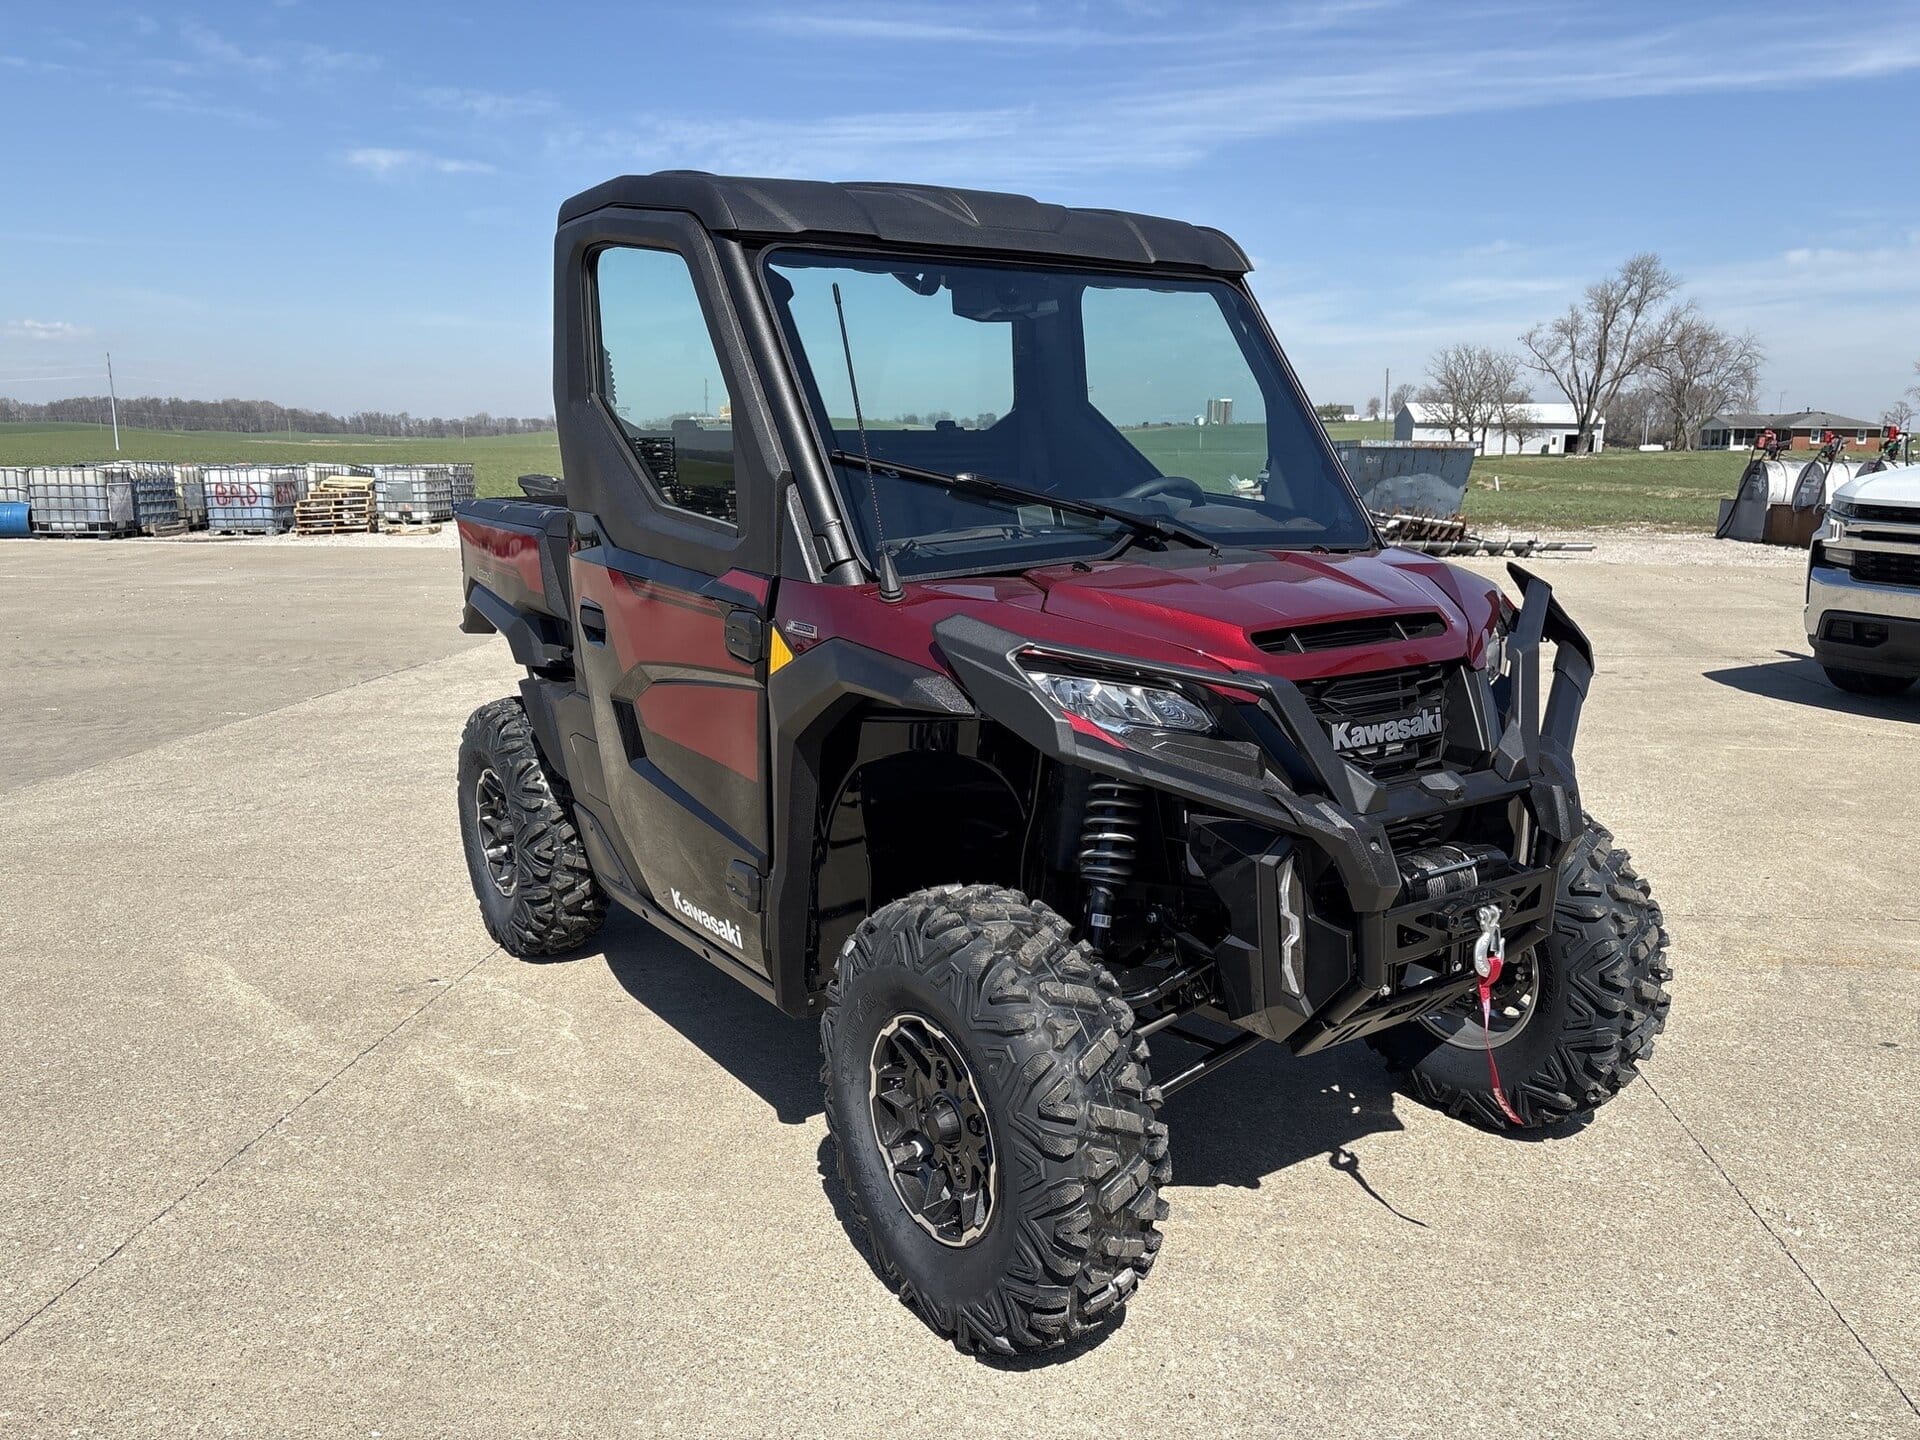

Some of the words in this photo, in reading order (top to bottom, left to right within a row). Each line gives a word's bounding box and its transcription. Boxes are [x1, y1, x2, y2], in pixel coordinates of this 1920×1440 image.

[215, 482, 258, 506] BAD
[1331, 707, 1443, 751] Kawasaki
[671, 888, 743, 949] Kawasaki
